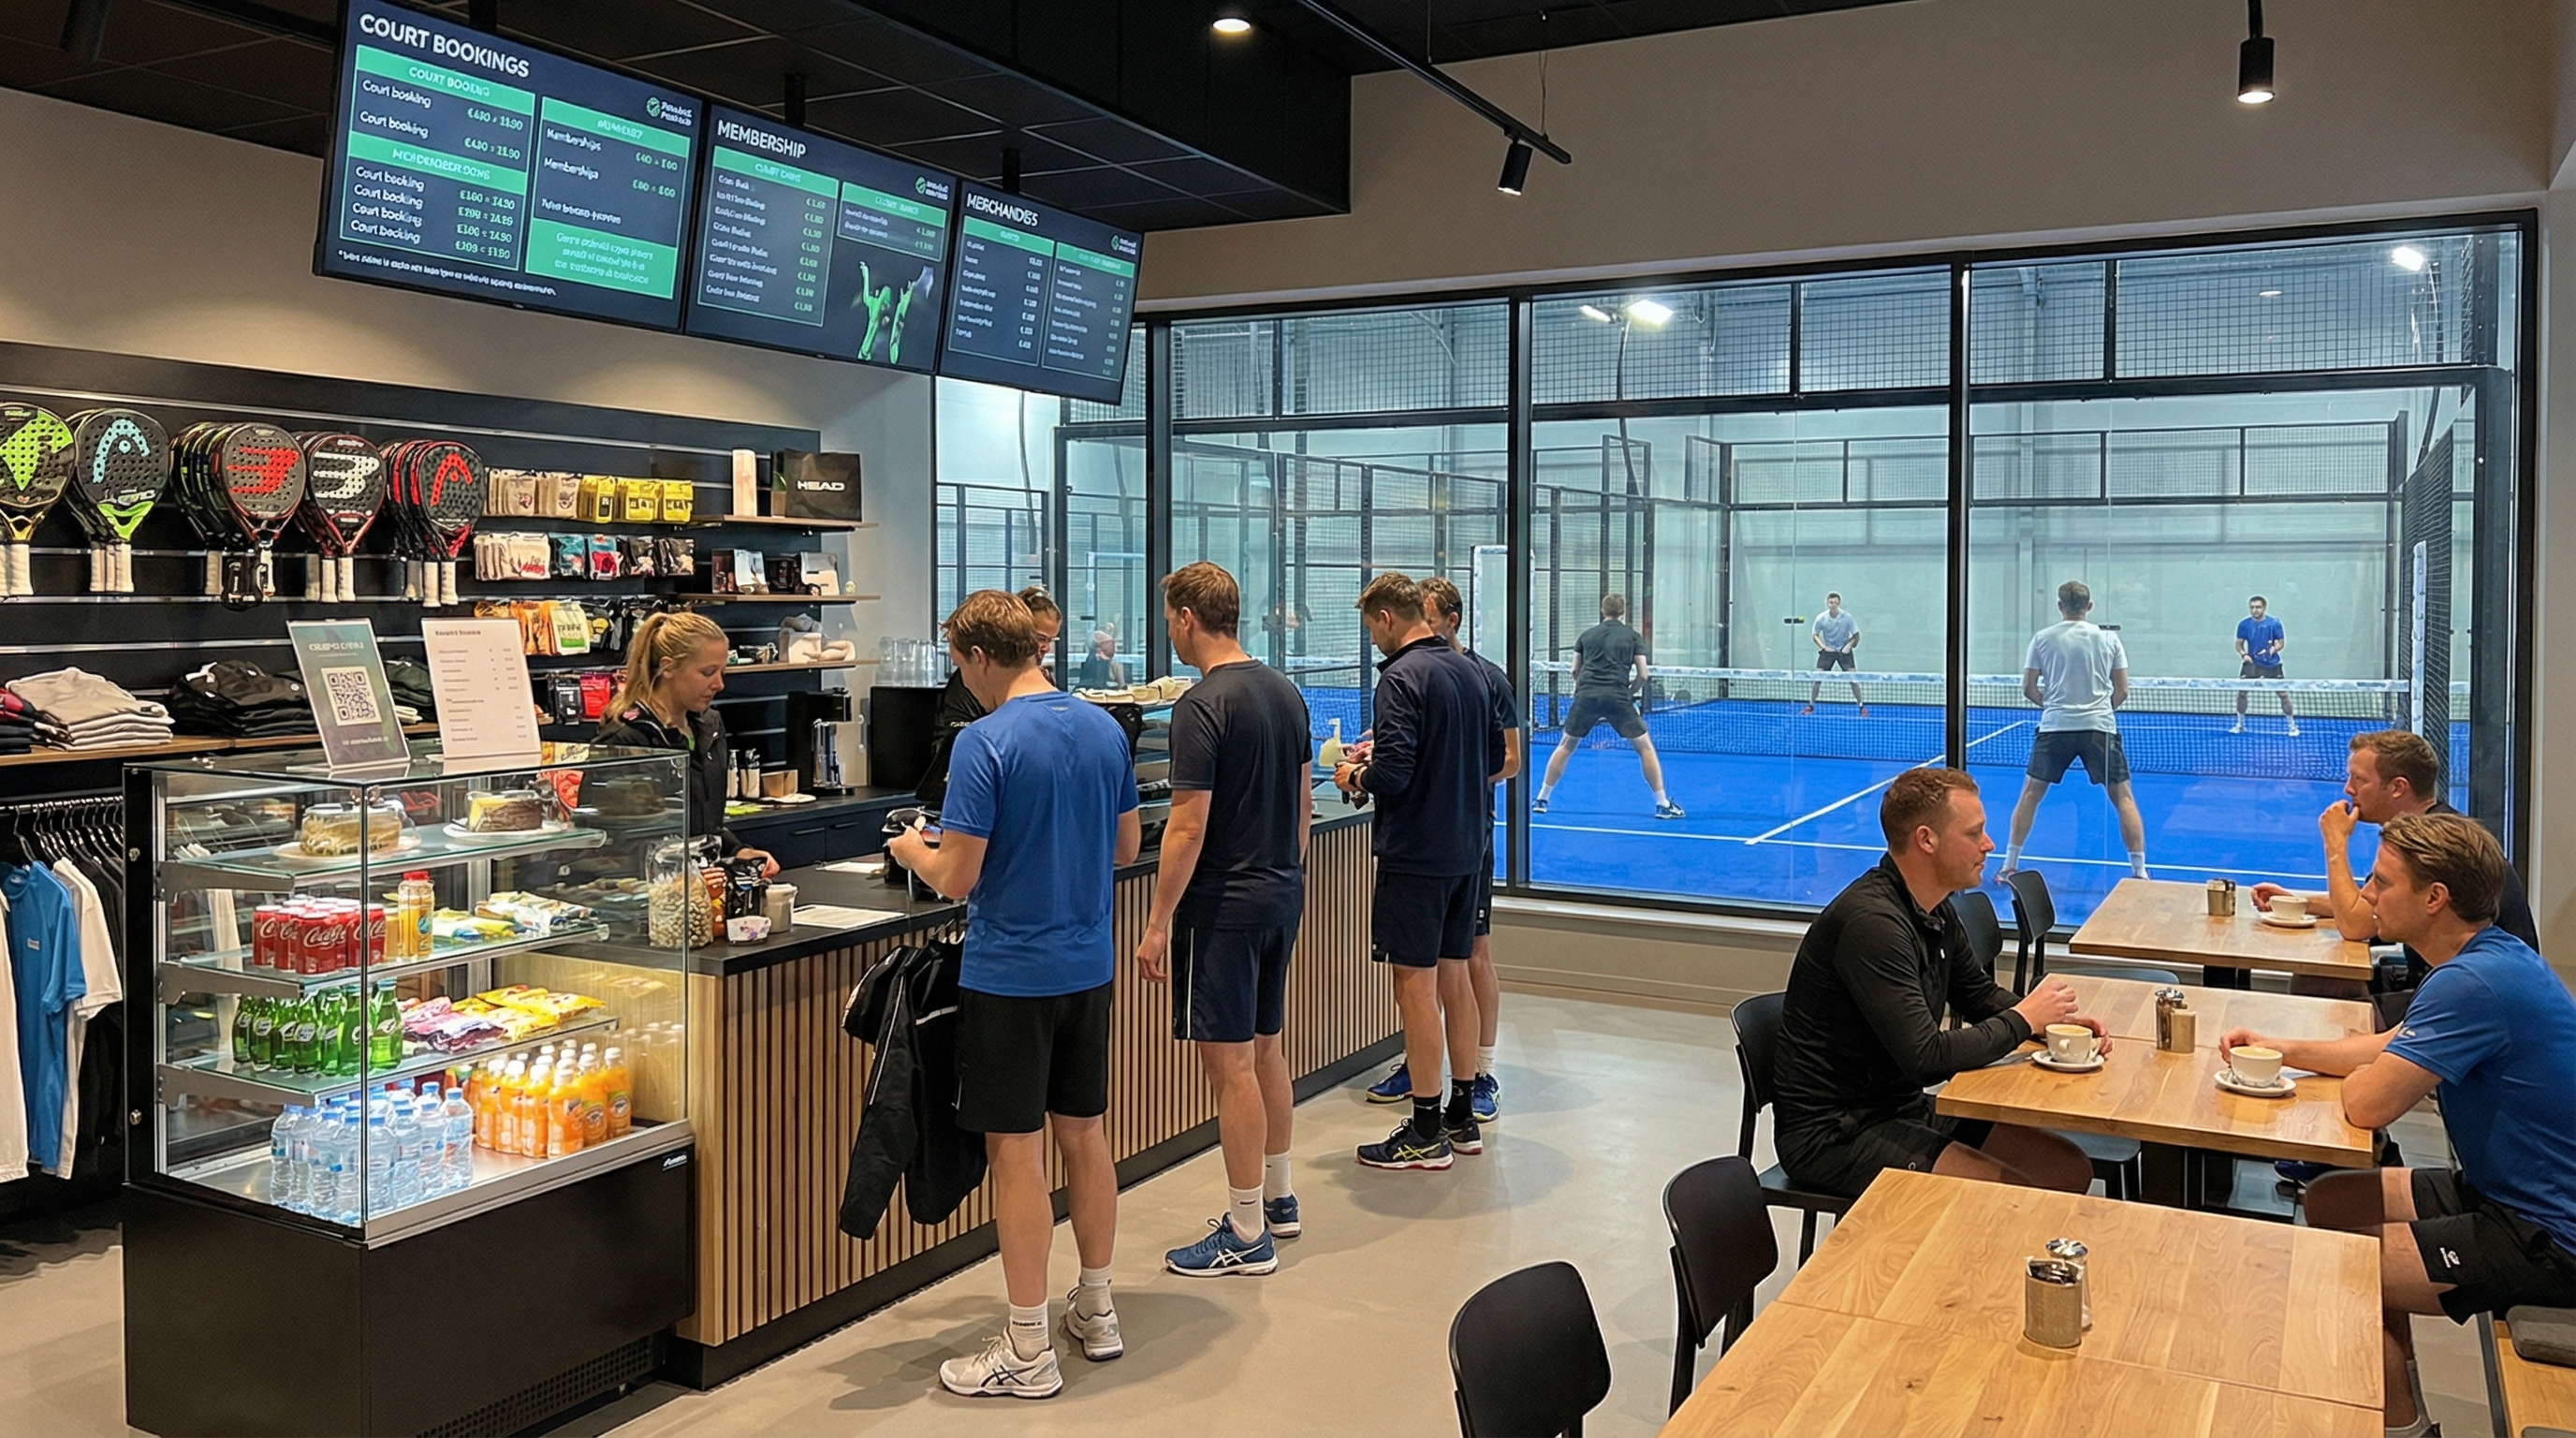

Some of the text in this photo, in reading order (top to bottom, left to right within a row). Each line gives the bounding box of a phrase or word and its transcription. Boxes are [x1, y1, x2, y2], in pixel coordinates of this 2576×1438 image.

[359, 13, 530, 78] COURT BOOKINGS
[717, 119, 807, 159] MEMBERSHIP
[797, 480, 844, 492] HEAD
